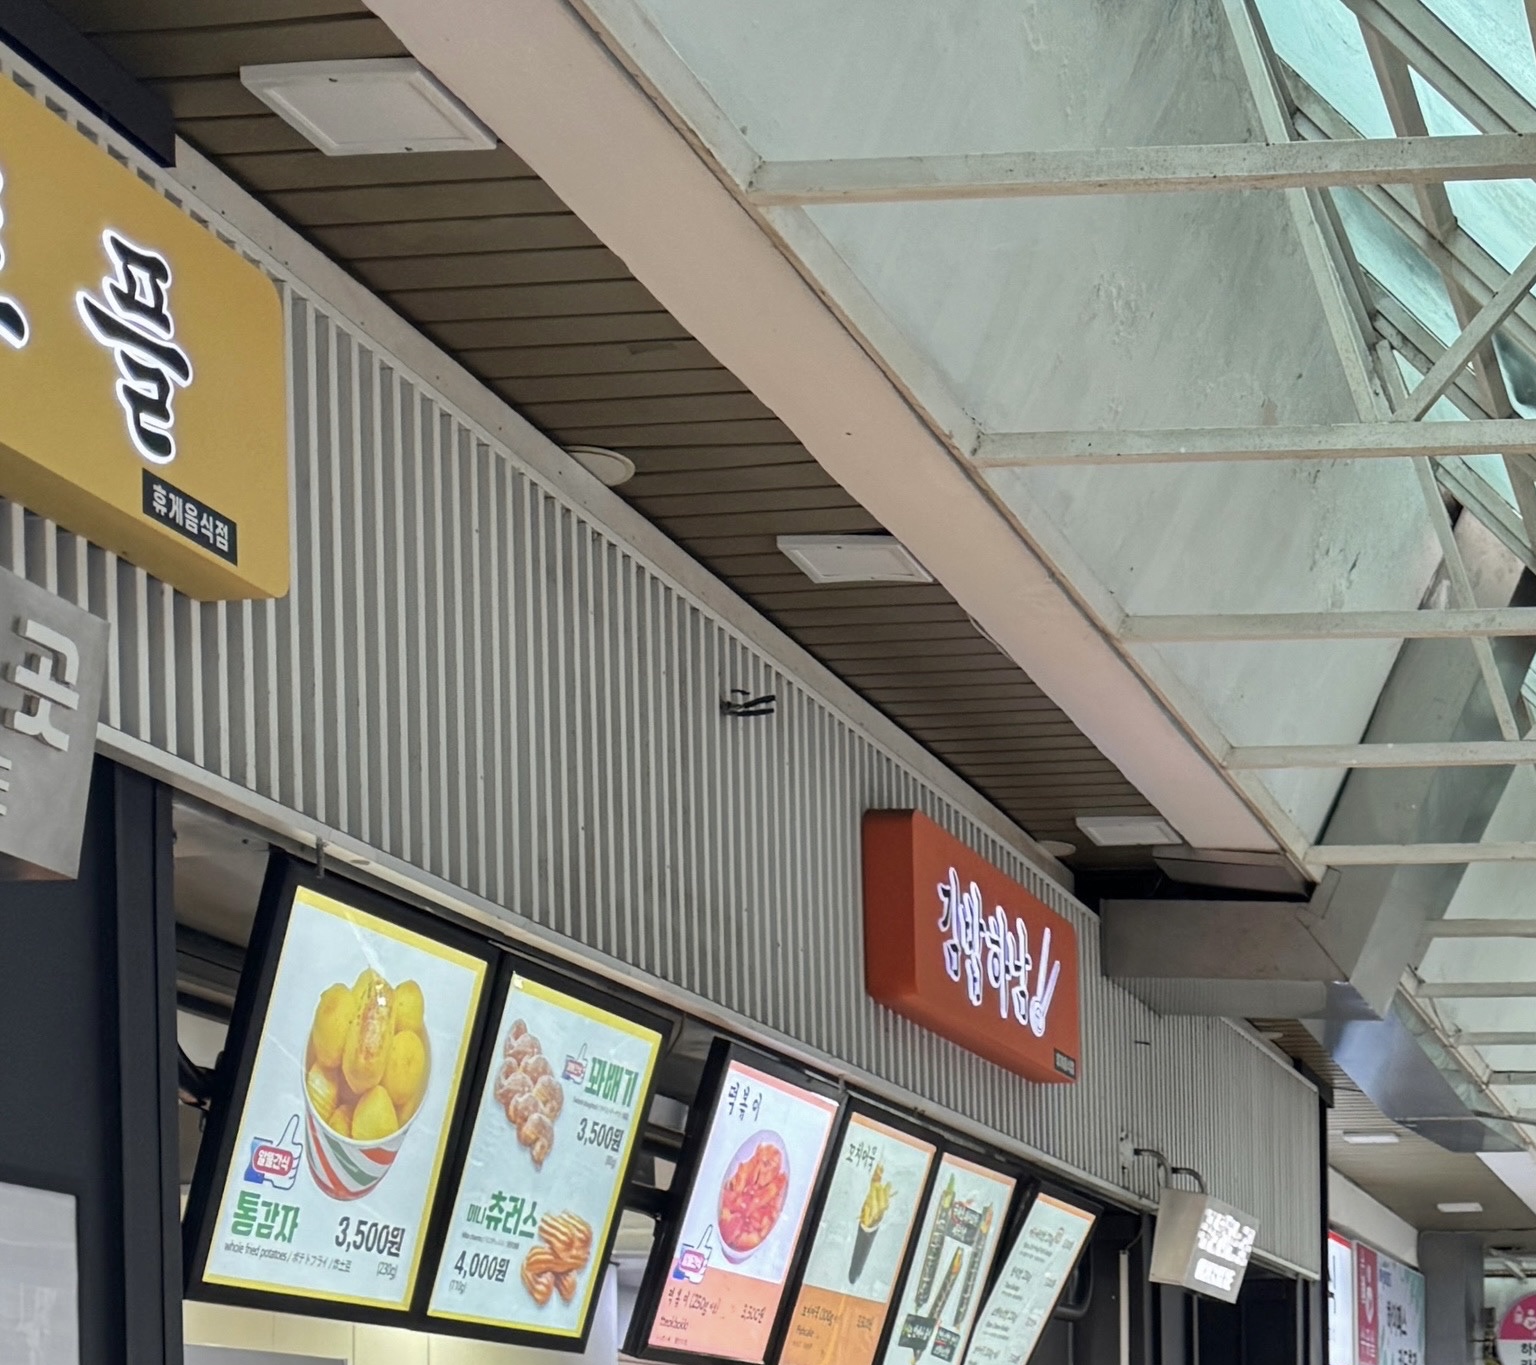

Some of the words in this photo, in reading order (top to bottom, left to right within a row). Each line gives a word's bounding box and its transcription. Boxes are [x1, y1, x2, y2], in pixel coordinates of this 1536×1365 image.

[153, 484, 229, 552] 휴게음식점
[584, 1057, 639, 1107] 꽈배기
[577, 1117, 624, 1153] 3,500원
[231, 1190, 300, 1243] 통감자
[335, 1216, 406, 1258] 3,500원
[224, 1240, 244, 1254] whole
[245, 1243, 260, 1257] fried
[259, 1246, 287, 1261] potatoes
[454, 1250, 510, 1283] 4,000원
